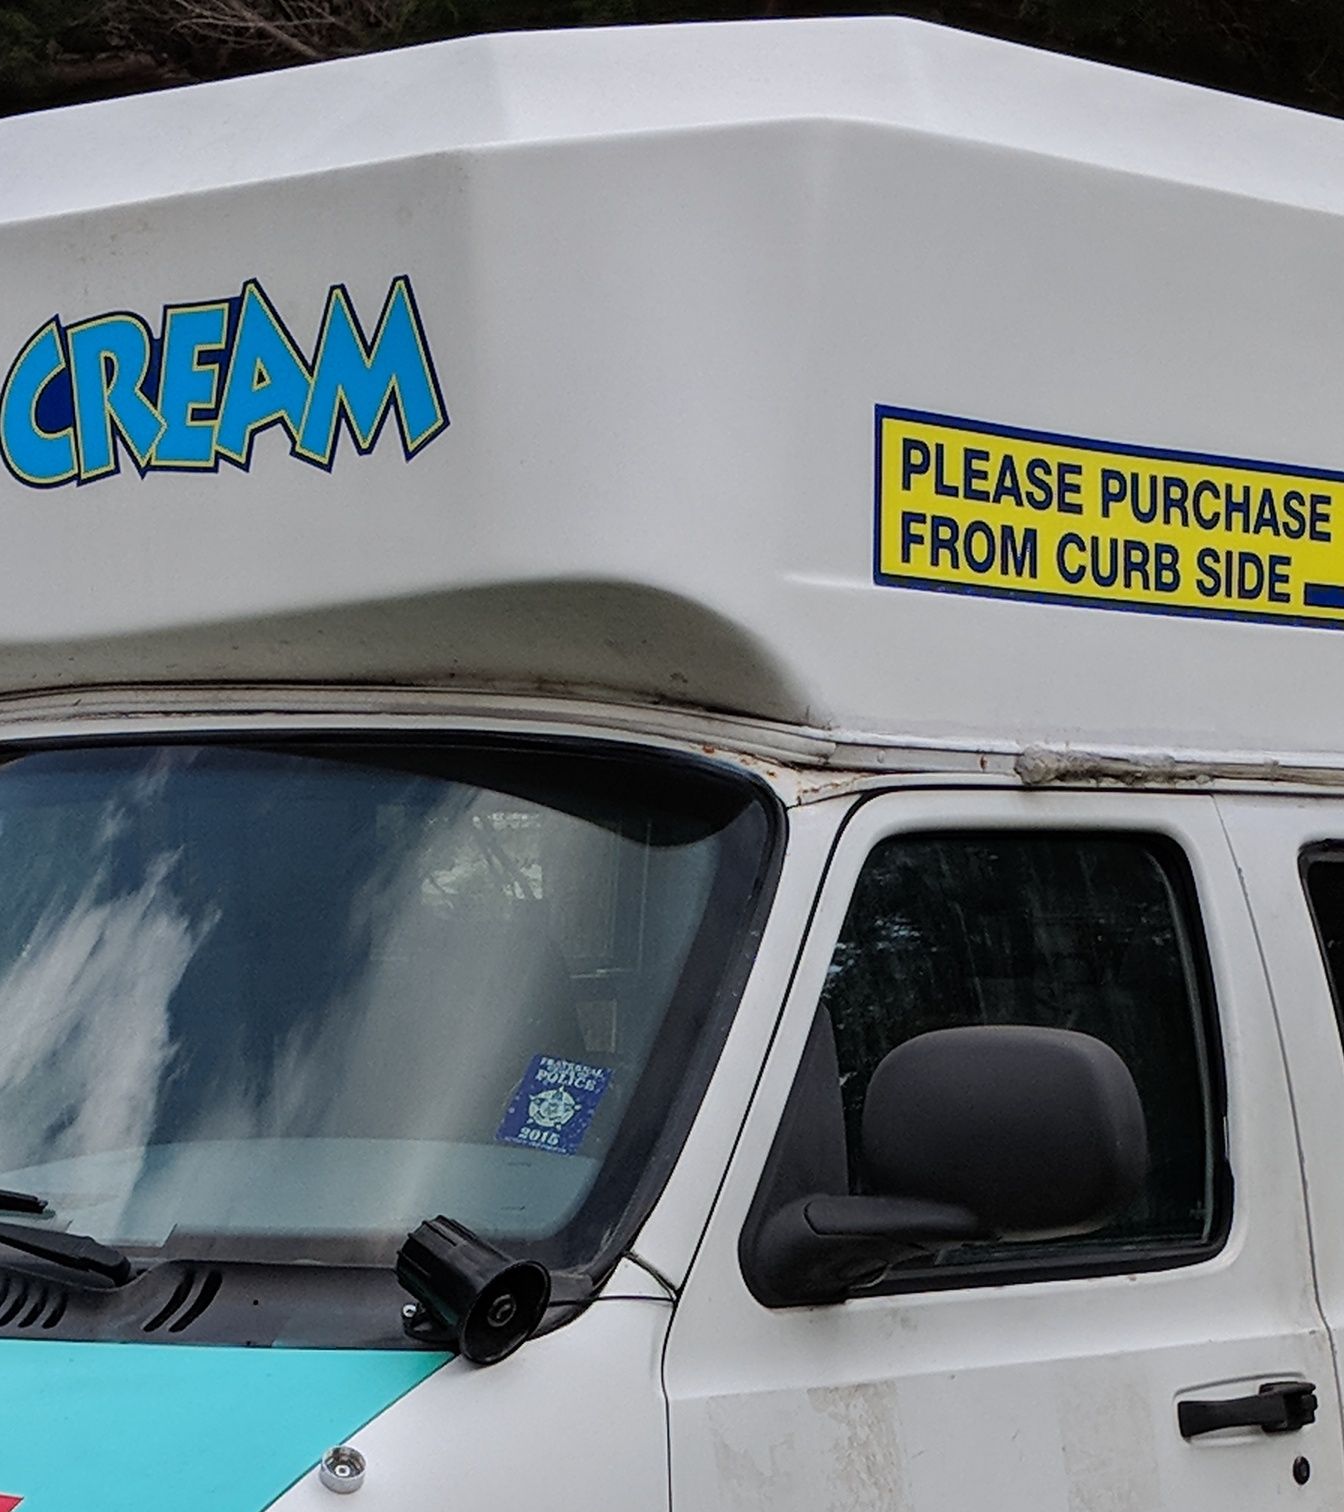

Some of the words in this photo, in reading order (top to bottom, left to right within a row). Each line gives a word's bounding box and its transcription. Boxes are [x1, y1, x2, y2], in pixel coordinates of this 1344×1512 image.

[901, 437, 1083, 515] PLEASE
[1101, 467, 1332, 542] PURCHASE
[900, 512, 1038, 579] FROM
[1057, 532, 1181, 594] CURB
[1196, 548, 1292, 602] SIDE
[535, 1069, 596, 1091] POLICE
